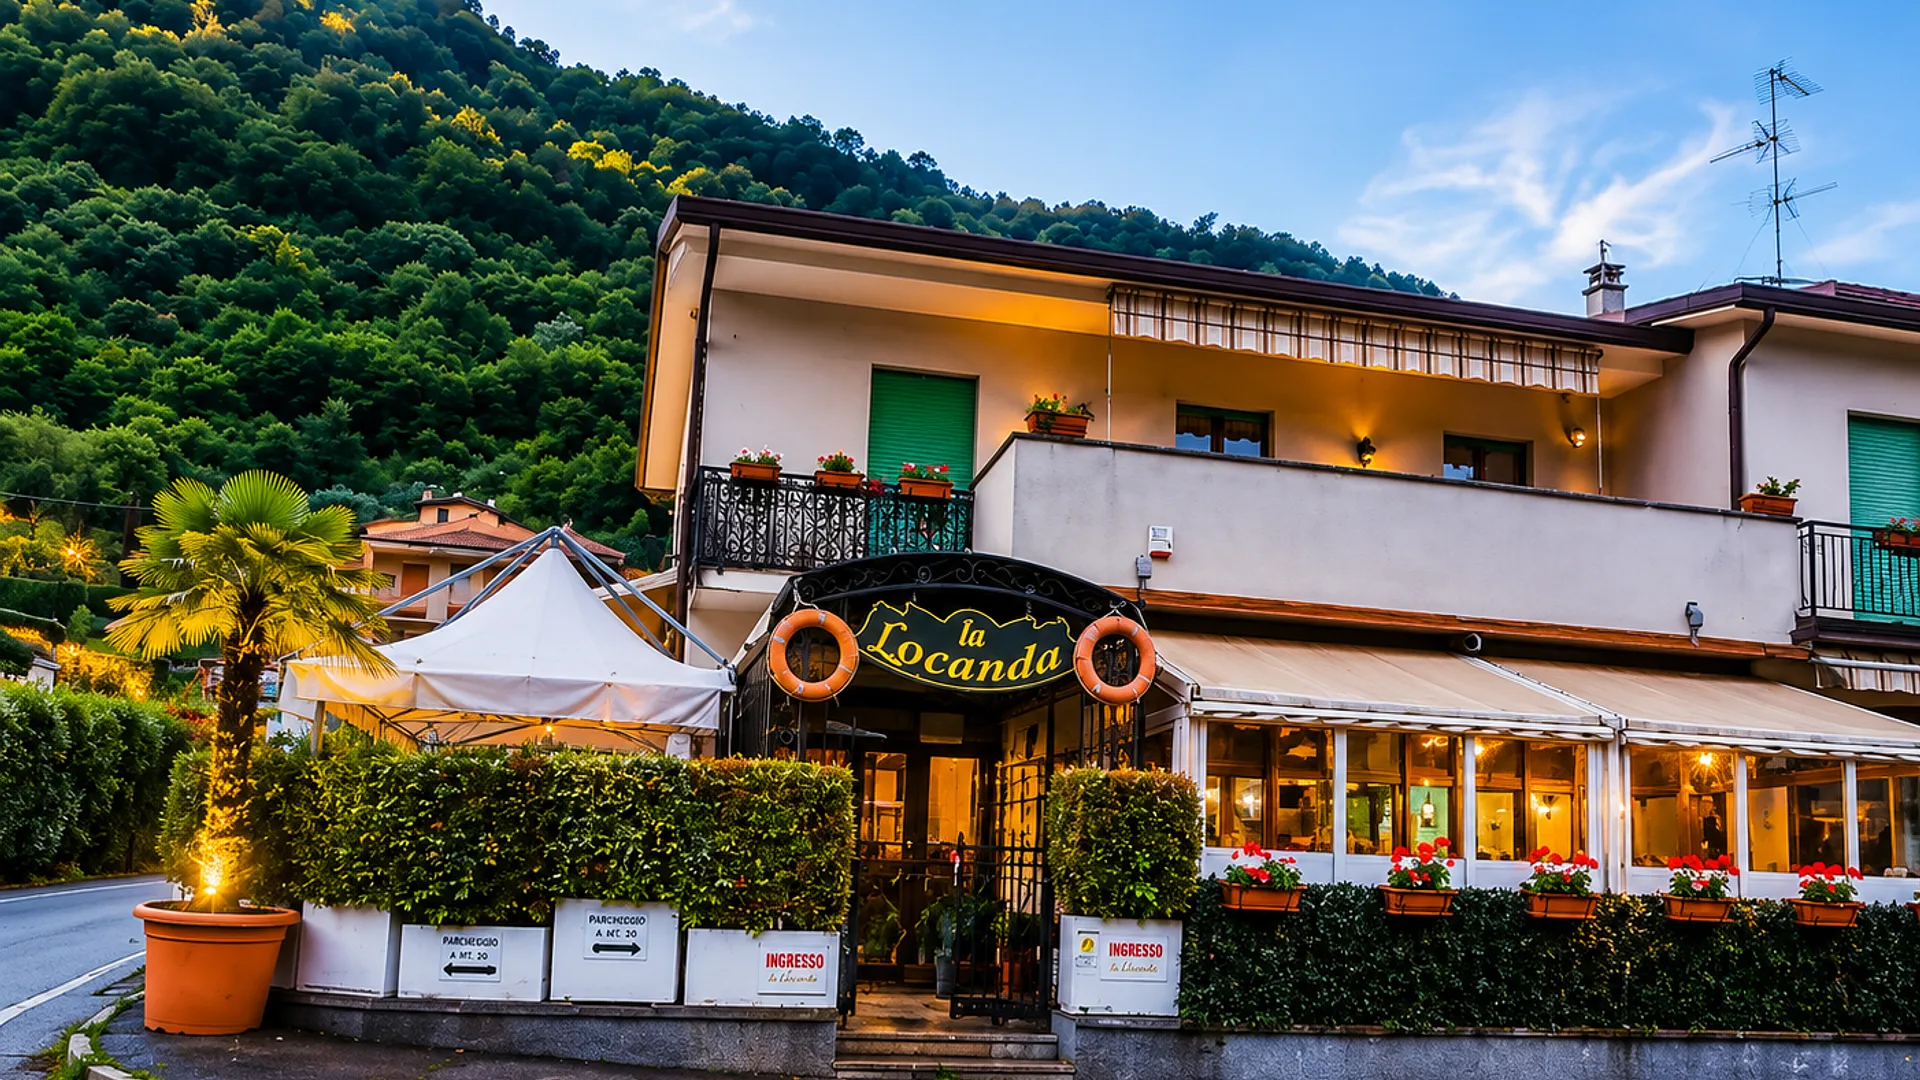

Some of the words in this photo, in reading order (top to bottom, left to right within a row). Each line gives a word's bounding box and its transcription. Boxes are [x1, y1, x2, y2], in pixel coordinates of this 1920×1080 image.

[957, 618, 986, 647] la
[866, 621, 1062, 682] Locanda
[588, 914, 646, 925] PARCHEGGIO
[595, 929, 602, 937] A
[442, 935, 499, 947] PARCHEGGIO
[449, 951, 456, 959] A
[1109, 942, 1163, 958] INGRESSO
[766, 952, 825, 969] INGRESSO
